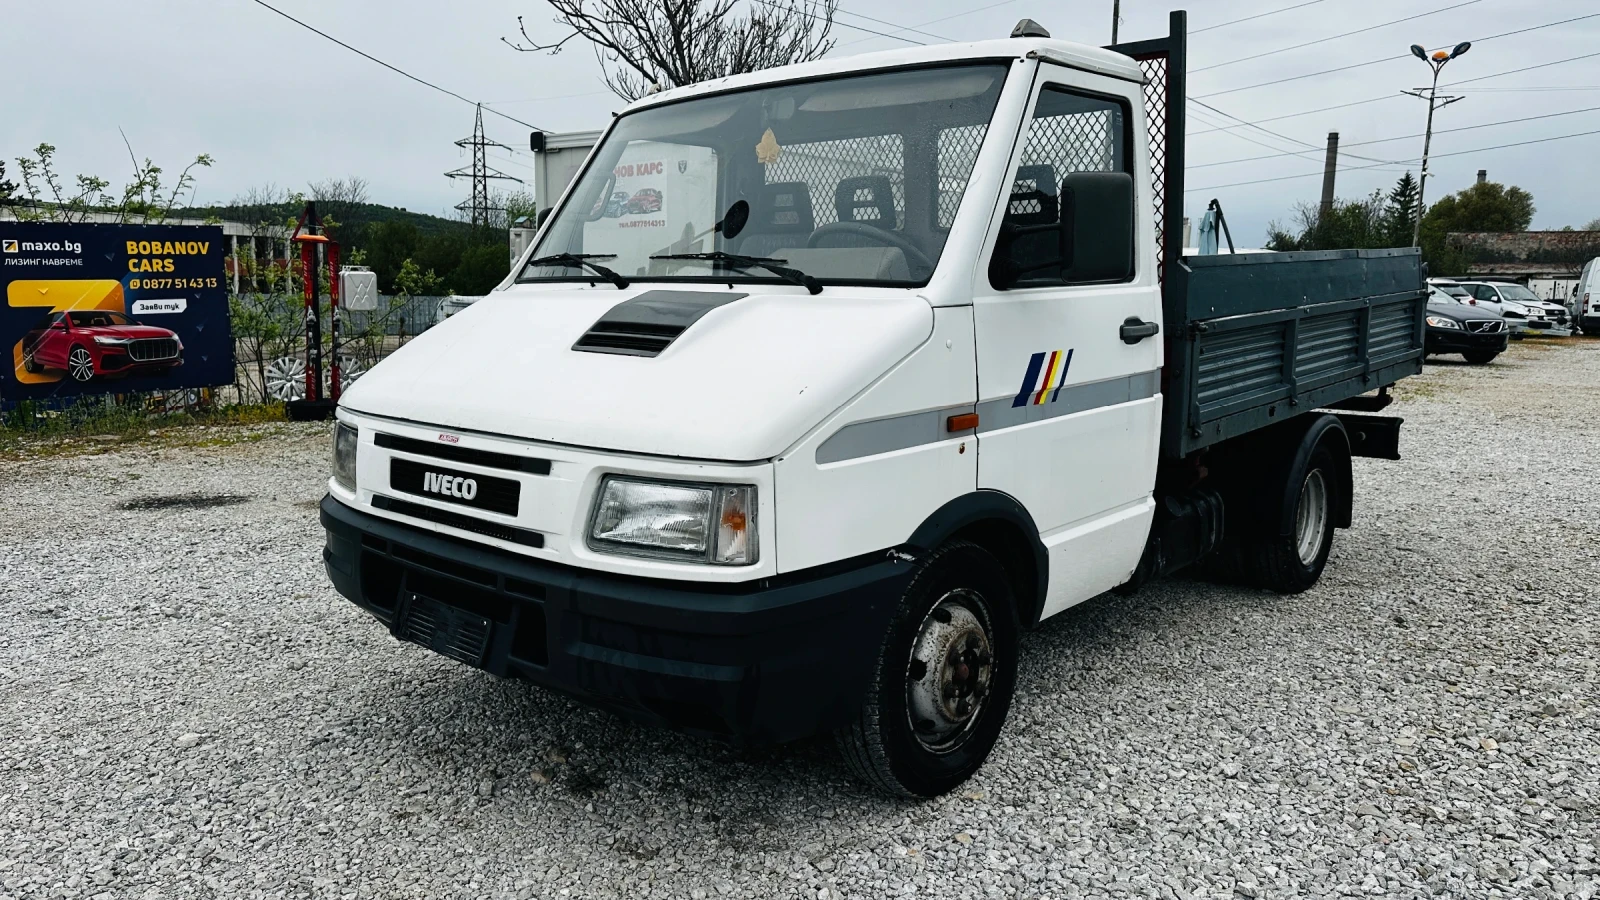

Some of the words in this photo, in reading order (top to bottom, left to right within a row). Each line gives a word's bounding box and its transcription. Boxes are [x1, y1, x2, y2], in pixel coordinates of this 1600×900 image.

[636, 161, 663, 177] КАРС
[21, 240, 82, 254] maxo.bg
[126, 240, 210, 255] BOBANOV
[4, 258, 41, 266] ЛИЗИНГ
[42, 258, 83, 266] НАВРЕМЕ
[128, 258, 175, 273] CARS
[142, 279, 172, 289] 0877
[174, 278, 187, 288] 51
[189, 278, 204, 288] 43
[205, 277, 217, 288] 13
[423, 471, 478, 500] IVECO
